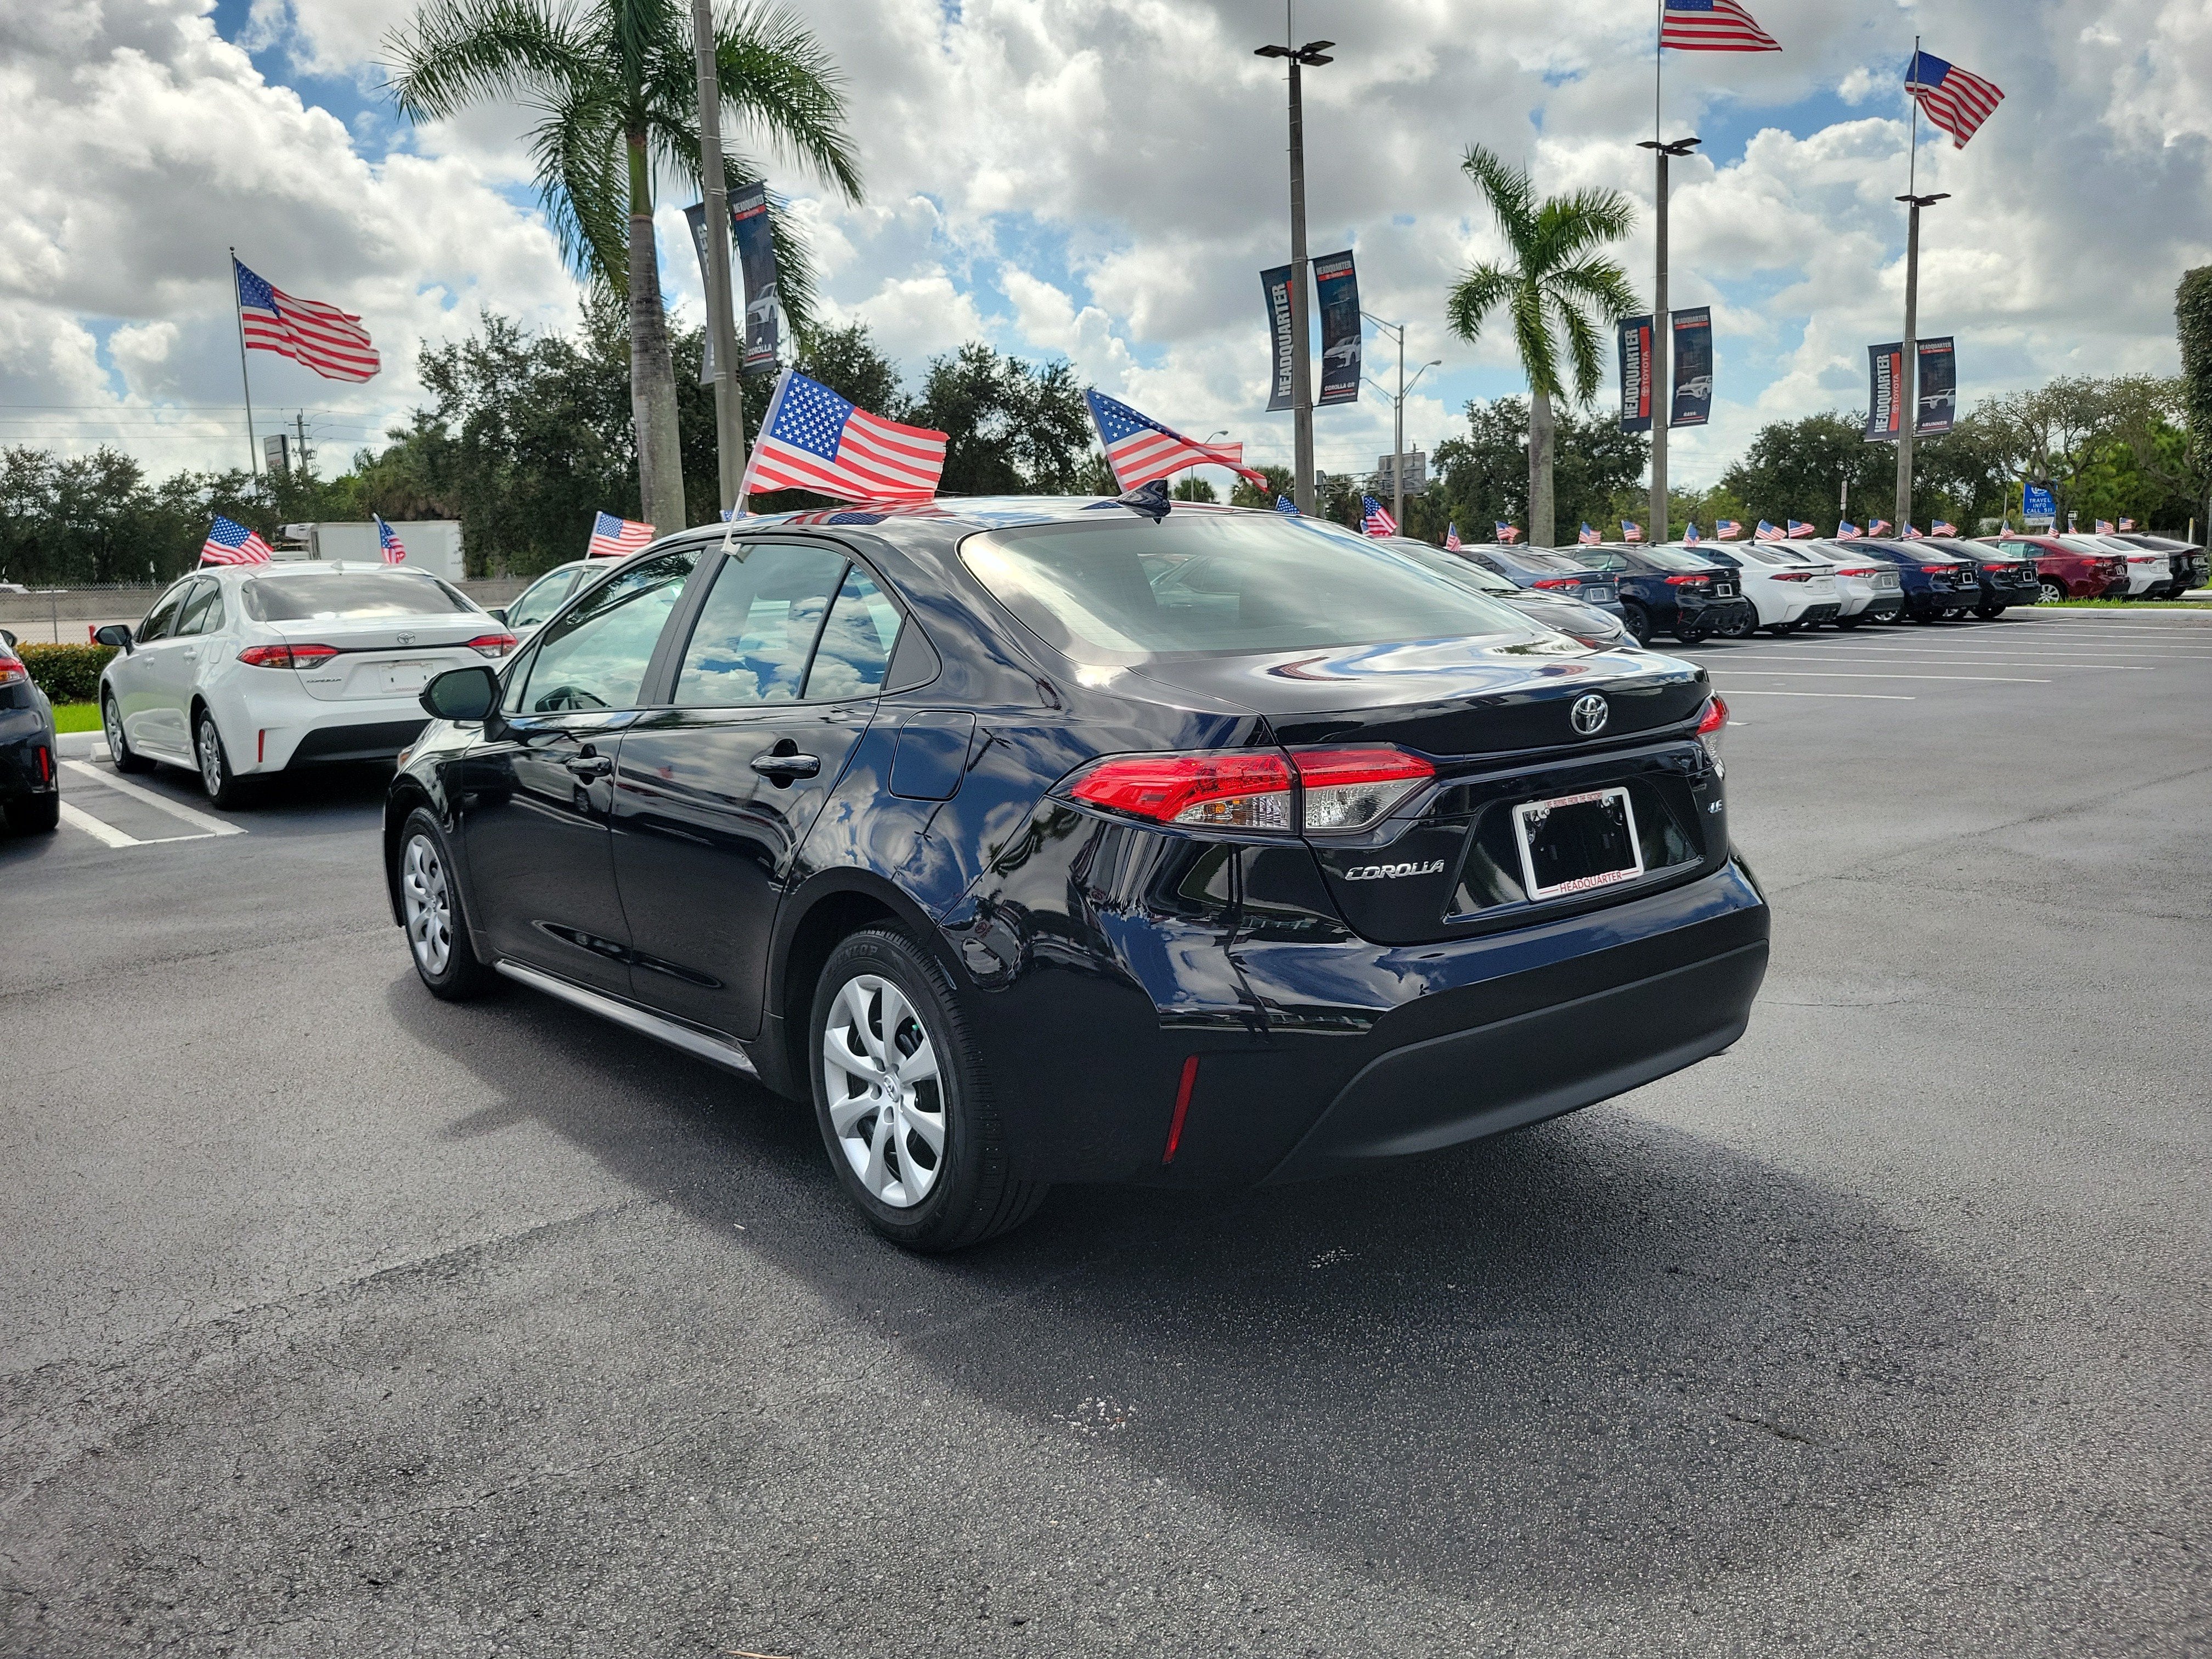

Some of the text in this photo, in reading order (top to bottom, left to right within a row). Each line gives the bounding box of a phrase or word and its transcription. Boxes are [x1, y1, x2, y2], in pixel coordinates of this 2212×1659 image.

[1272, 283, 1294, 397] HEADQUARTER
[1641, 351, 1650, 385] TOYOTA
[1624, 329, 1641, 420] HEADQUARTER
[1874, 354, 1892, 433] HEADQUARTER
[1345, 859, 1444, 881] COROLLA
[1560, 871, 1623, 893] HEADQUARTER
